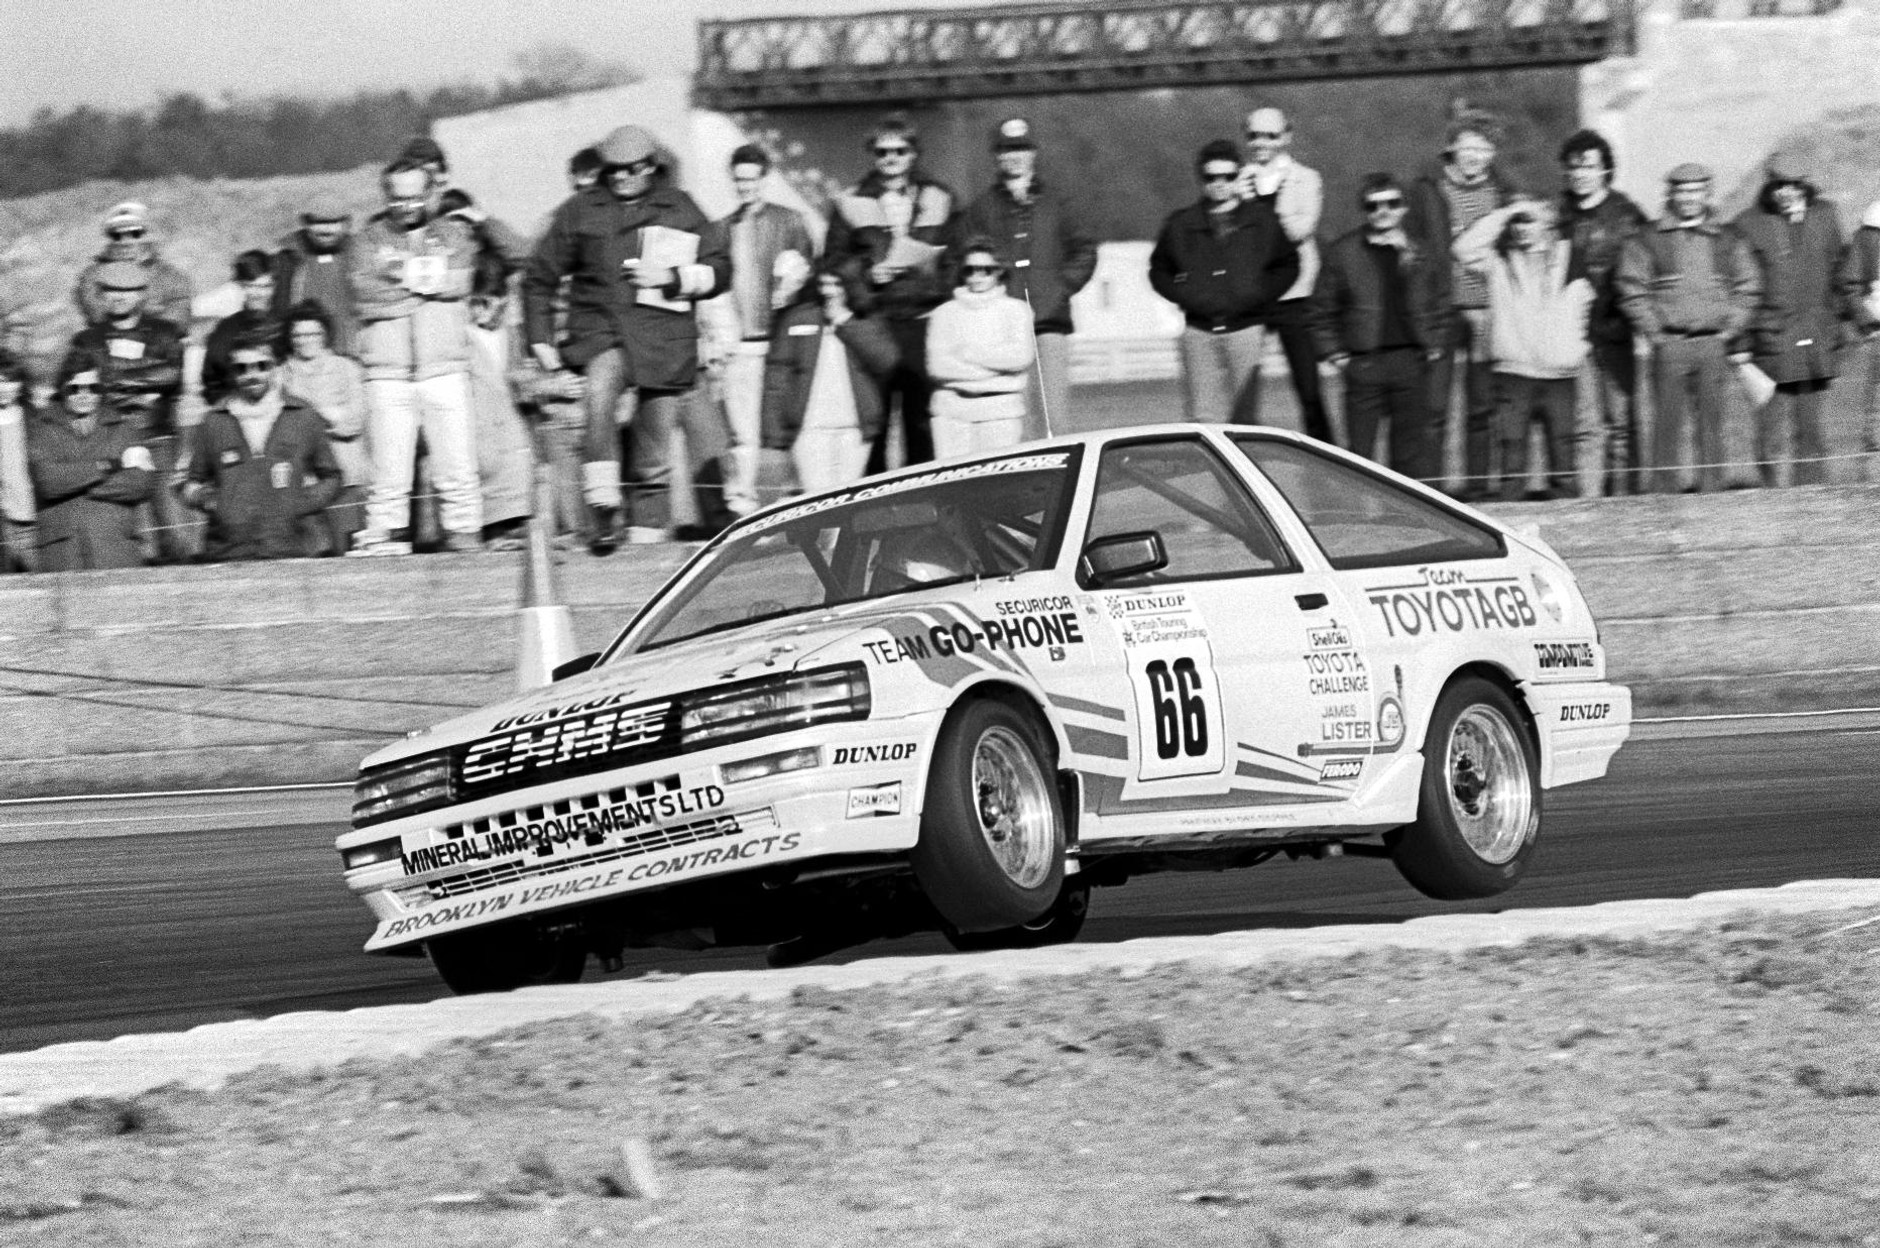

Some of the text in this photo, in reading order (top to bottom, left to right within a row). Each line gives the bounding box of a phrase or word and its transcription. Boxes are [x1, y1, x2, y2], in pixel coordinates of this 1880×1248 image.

[1418, 567, 1465, 586] Team
[996, 596, 1073, 615] SECURICOR
[1124, 595, 1186, 611] DUNLOP
[862, 613, 1084, 665] TEAM GO-PHONE
[1312, 632, 1332, 646] Shell
[1303, 652, 1366, 675] TOYOTA
[1310, 676, 1369, 695] CHALLENGE
[1146, 657, 1208, 760] 66
[1321, 704, 1357, 719] JAMES
[1560, 703, 1610, 721] DUNLOP
[1322, 721, 1372, 741] LISTER
[833, 743, 916, 765] DUNLOP
[1321, 761, 1363, 779] FERODO
[678, 785, 725, 814] LTD
[851, 793, 898, 808] CHAMPION
[384, 833, 801, 939] BROOKLYN VEHICLE CONTRACTS
